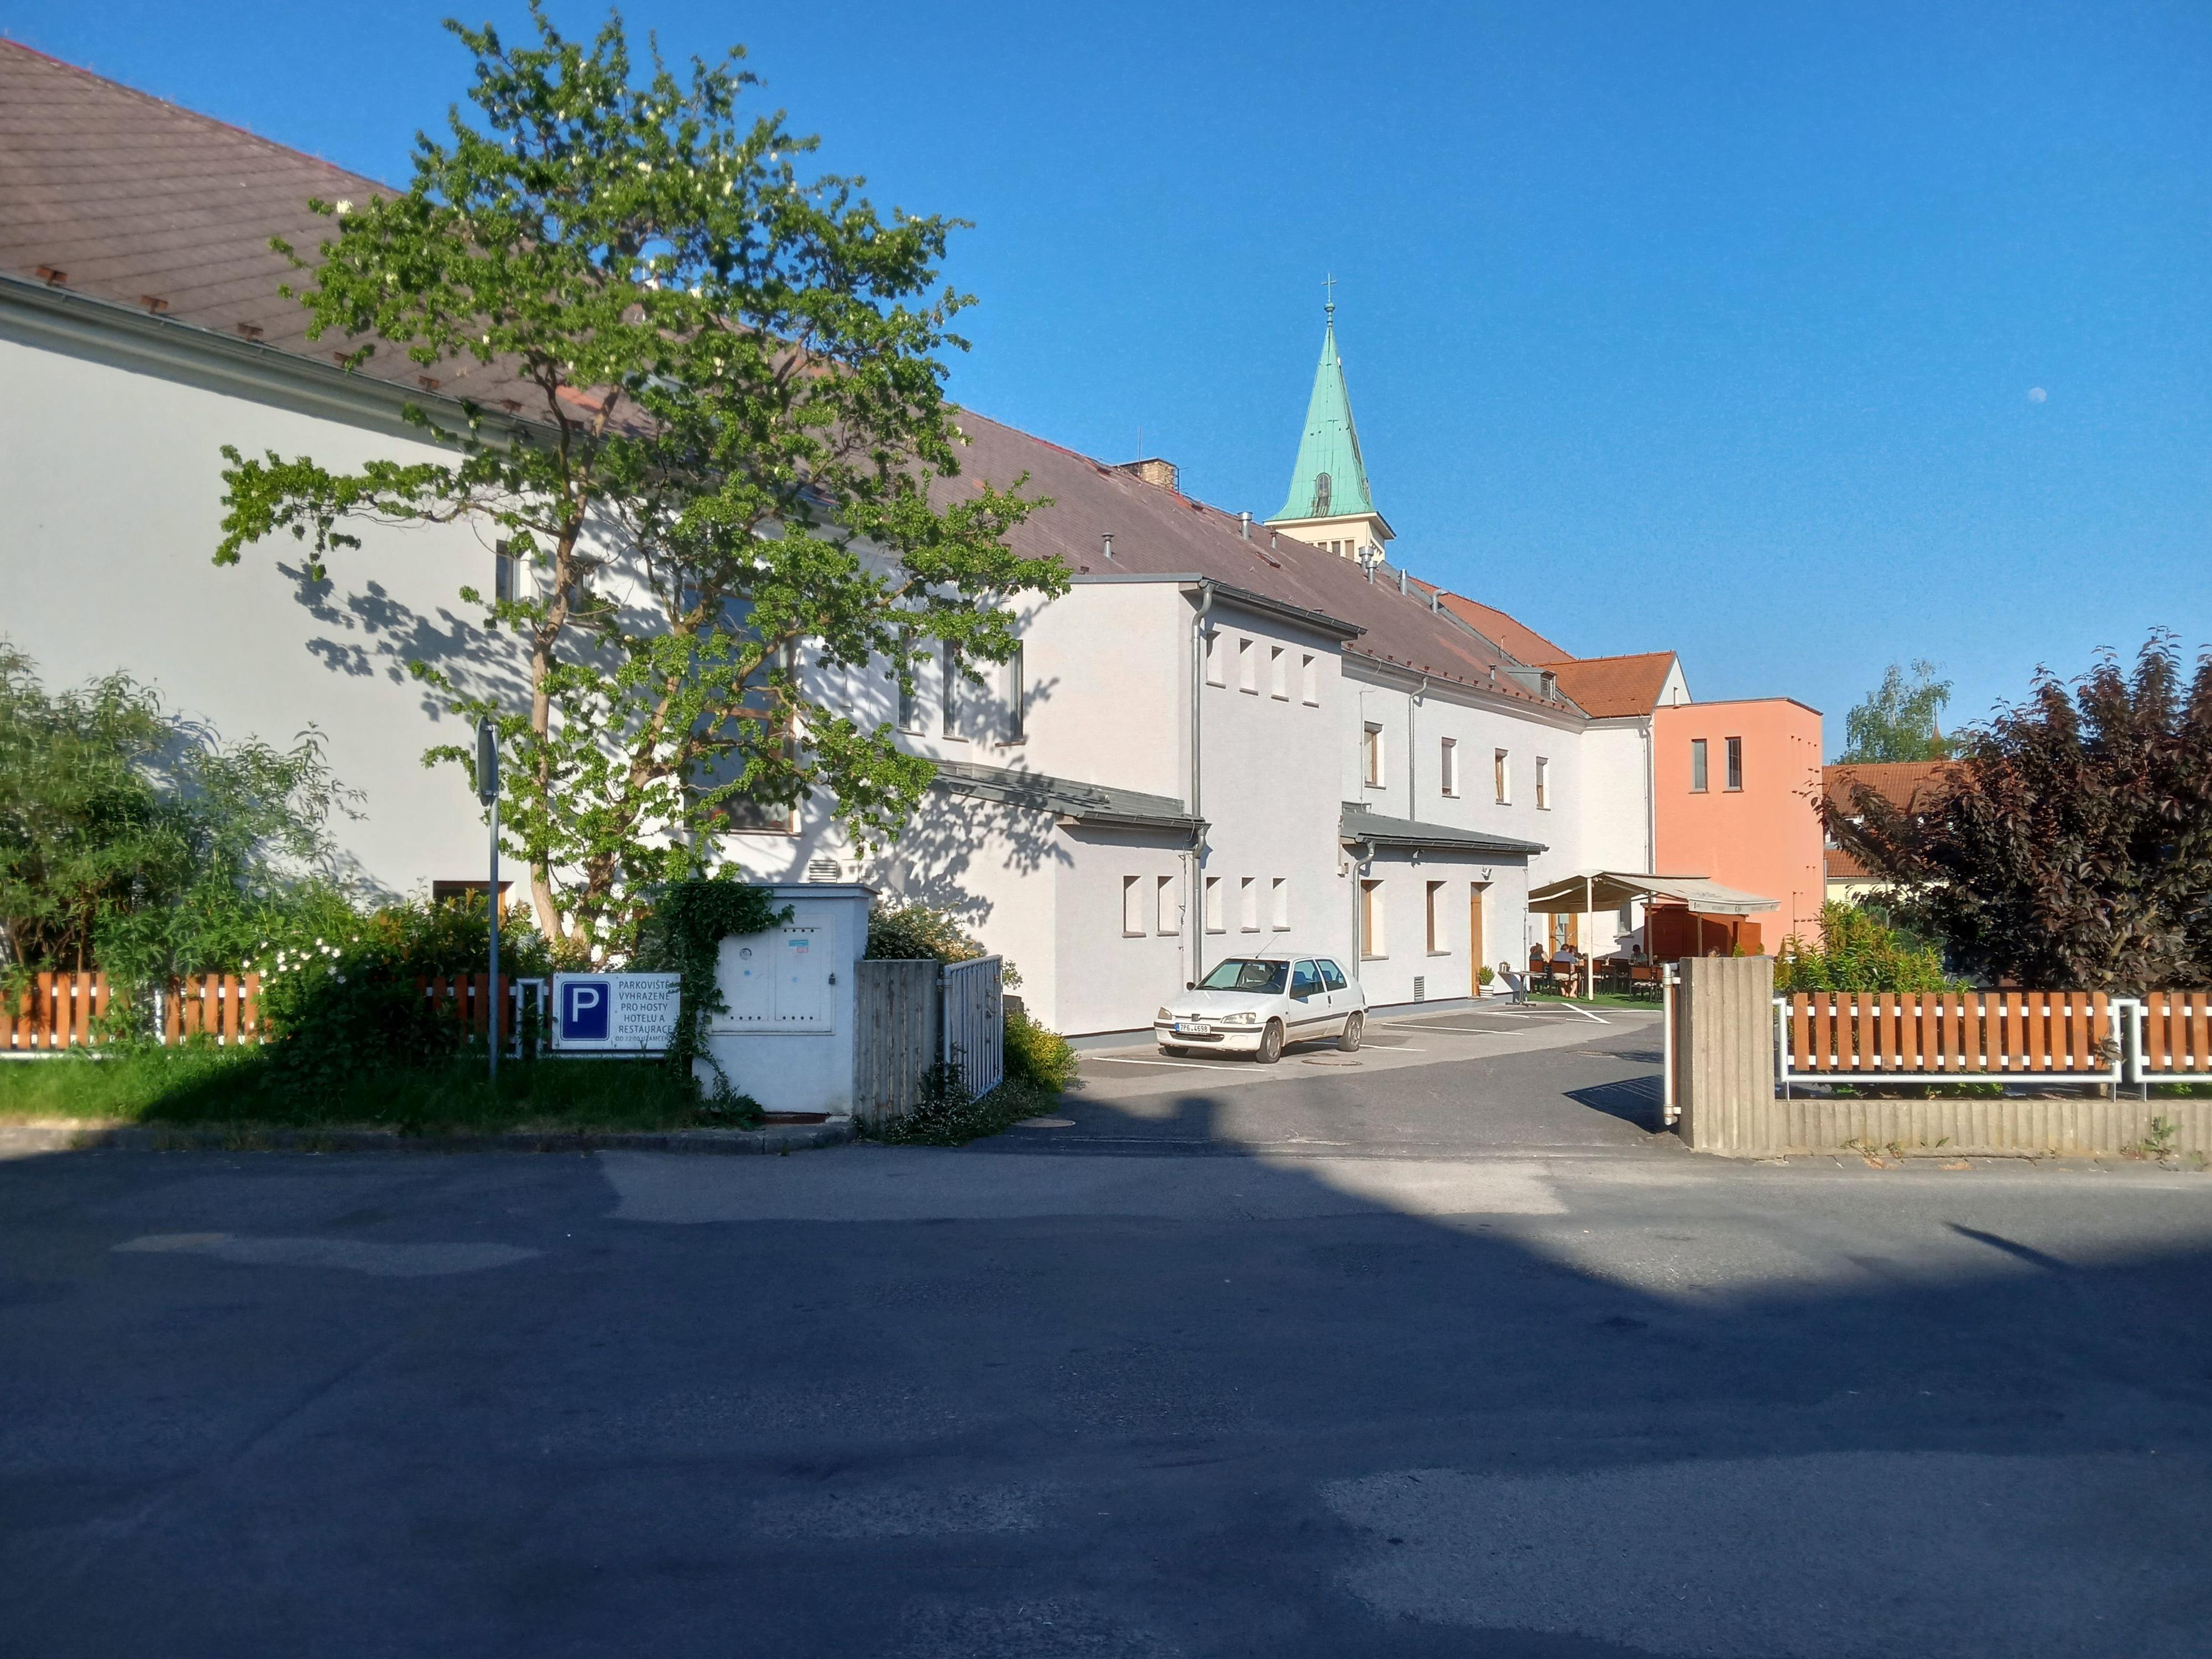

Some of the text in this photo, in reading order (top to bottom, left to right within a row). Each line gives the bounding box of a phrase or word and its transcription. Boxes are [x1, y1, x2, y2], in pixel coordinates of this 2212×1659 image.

[619, 979, 670, 989] PARKOVIŠTĚ
[573, 988, 599, 1022] P
[624, 1014, 665, 1022] HOTELU A
[619, 1025, 672, 1034] RESTAURACE
